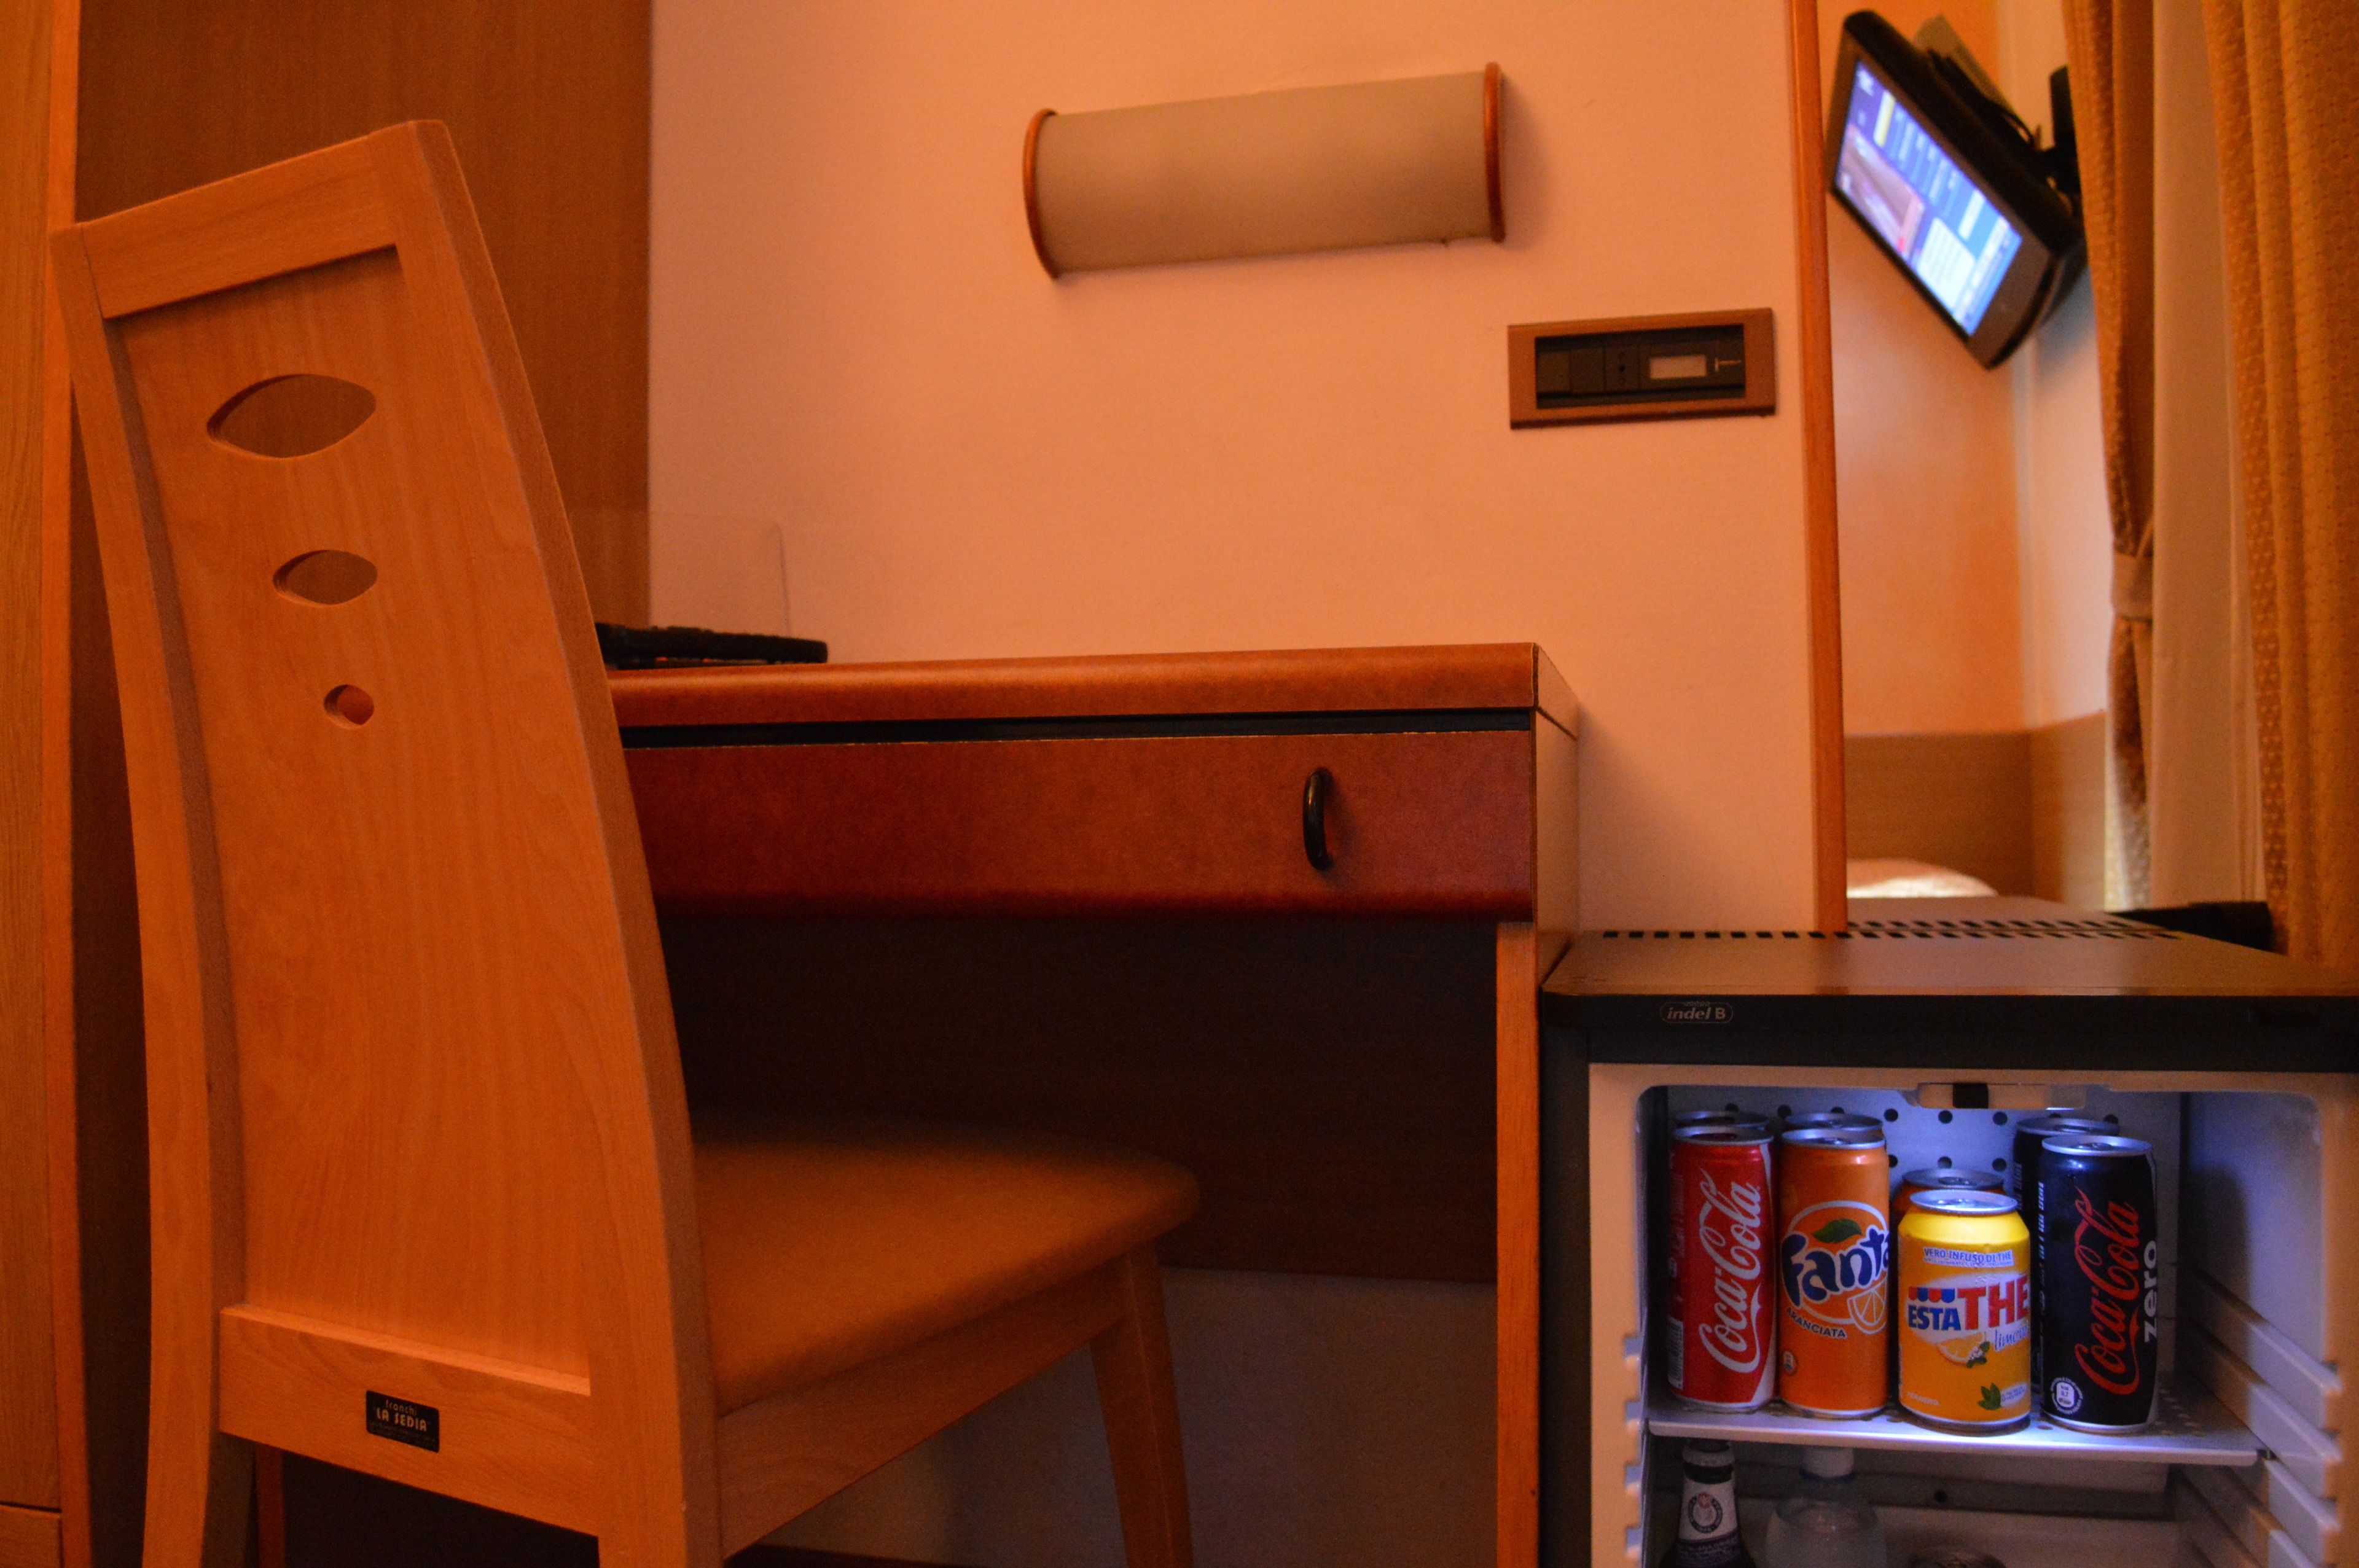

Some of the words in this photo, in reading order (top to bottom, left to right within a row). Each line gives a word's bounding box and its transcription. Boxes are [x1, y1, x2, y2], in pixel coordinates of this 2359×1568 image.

[1667, 1007, 1712, 1020] indel
[1715, 1007, 1726, 1020] B
[1698, 1167, 1762, 1374] Coca-Cola
[1923, 1248, 1946, 1258] VERO
[1949, 1250, 1984, 1263] INFUSO
[1997, 1250, 2012, 1261] THE
[2073, 1185, 2140, 1396] Coca-Cola
[2143, 1240, 2158, 1344] zero
[1786, 1307, 1847, 1339] ARANCIATA
[376, 1407, 389, 1421] LA
[394, 1412, 428, 1432] SEDIA
